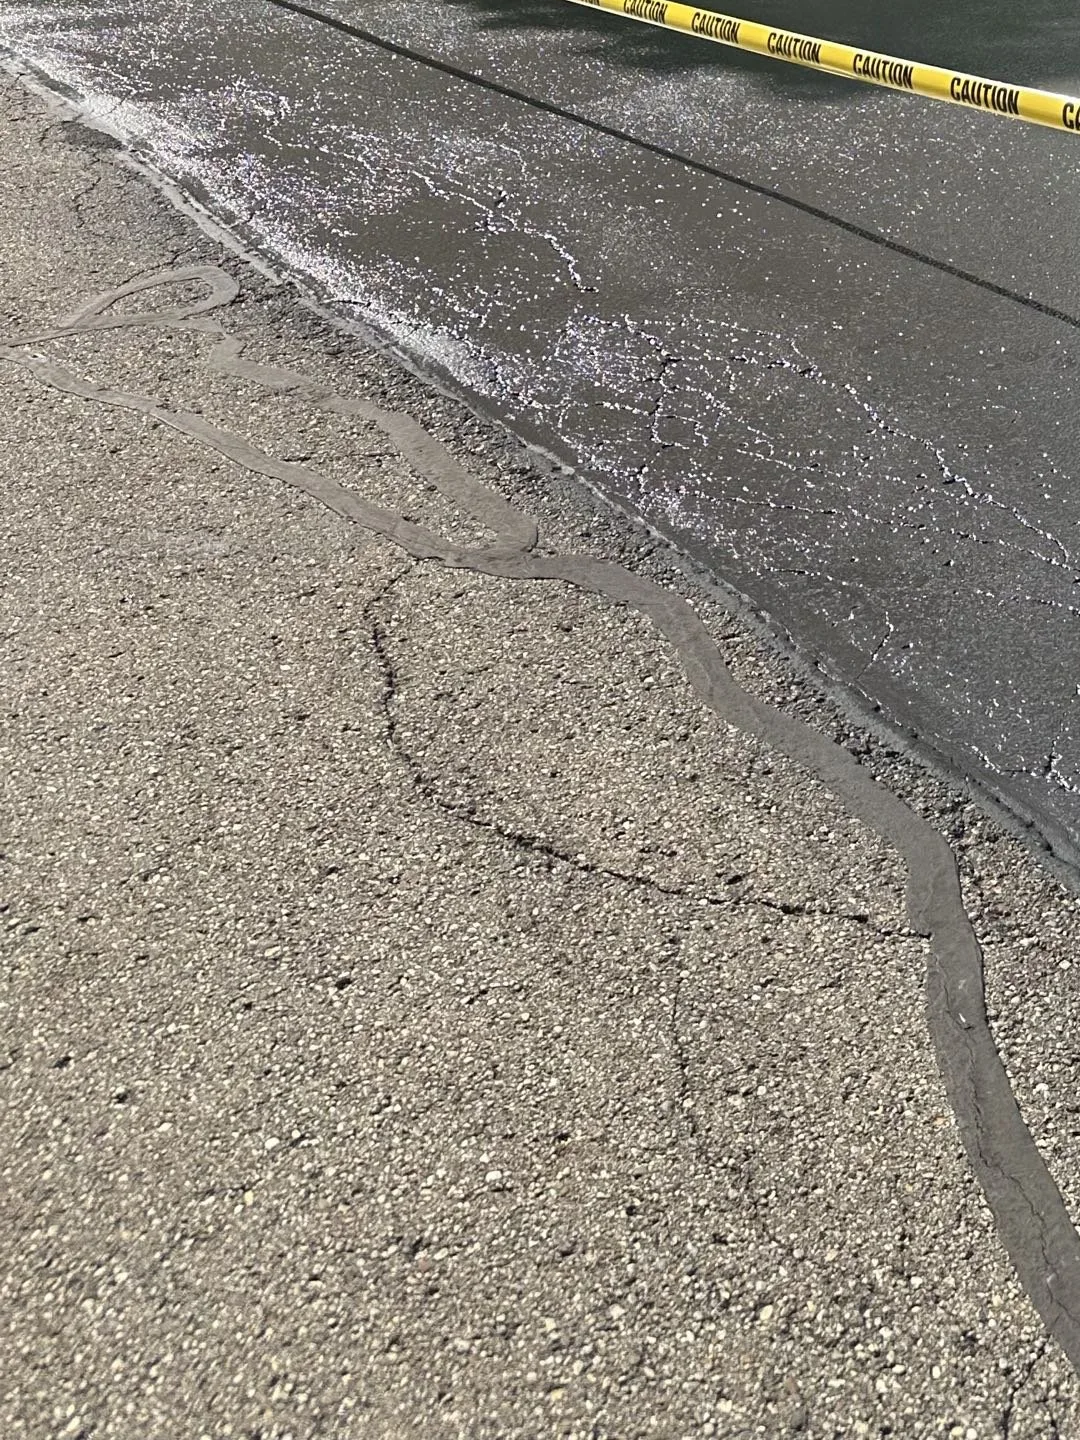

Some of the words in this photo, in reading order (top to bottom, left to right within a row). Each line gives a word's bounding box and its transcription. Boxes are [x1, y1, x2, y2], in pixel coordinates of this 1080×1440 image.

[691, 12, 741, 44] CAUTION
[767, 32, 821, 64] CAUTION
[852, 53, 913, 90] CAUTION
[950, 77, 1019, 115] CAUTION
